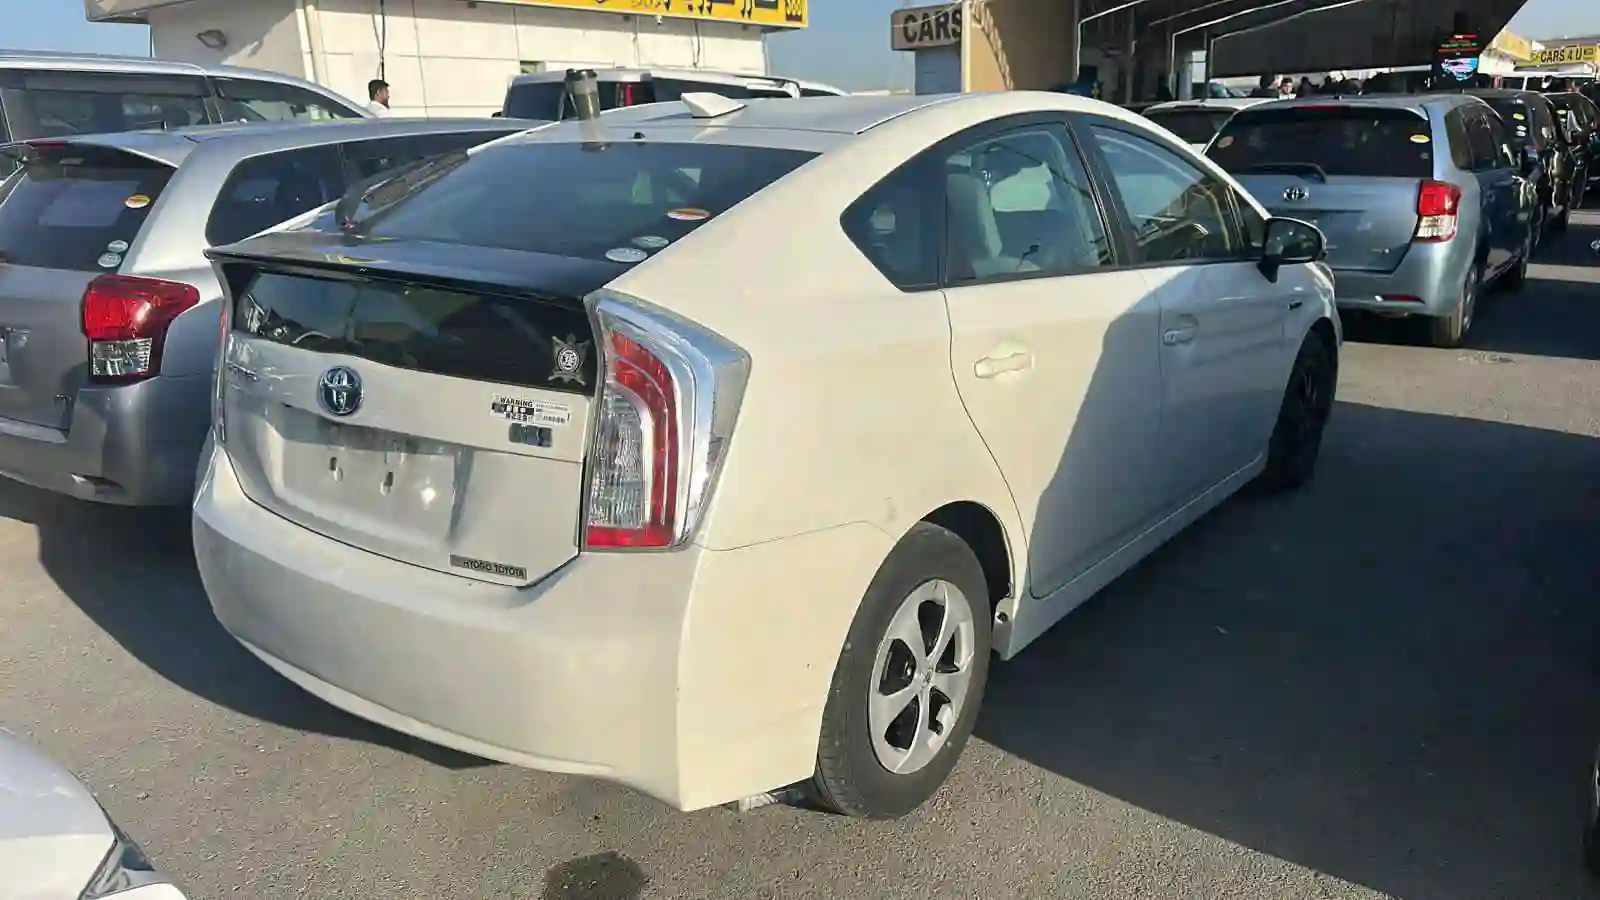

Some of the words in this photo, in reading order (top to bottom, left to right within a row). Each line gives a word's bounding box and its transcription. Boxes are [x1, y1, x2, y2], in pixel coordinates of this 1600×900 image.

[903, 9, 962, 43] CARS
[1540, 50, 1565, 63] CARS
[1575, 47, 1583, 60] U
[500, 396, 533, 408] WARNING
[494, 563, 525, 577] TOYOTA
